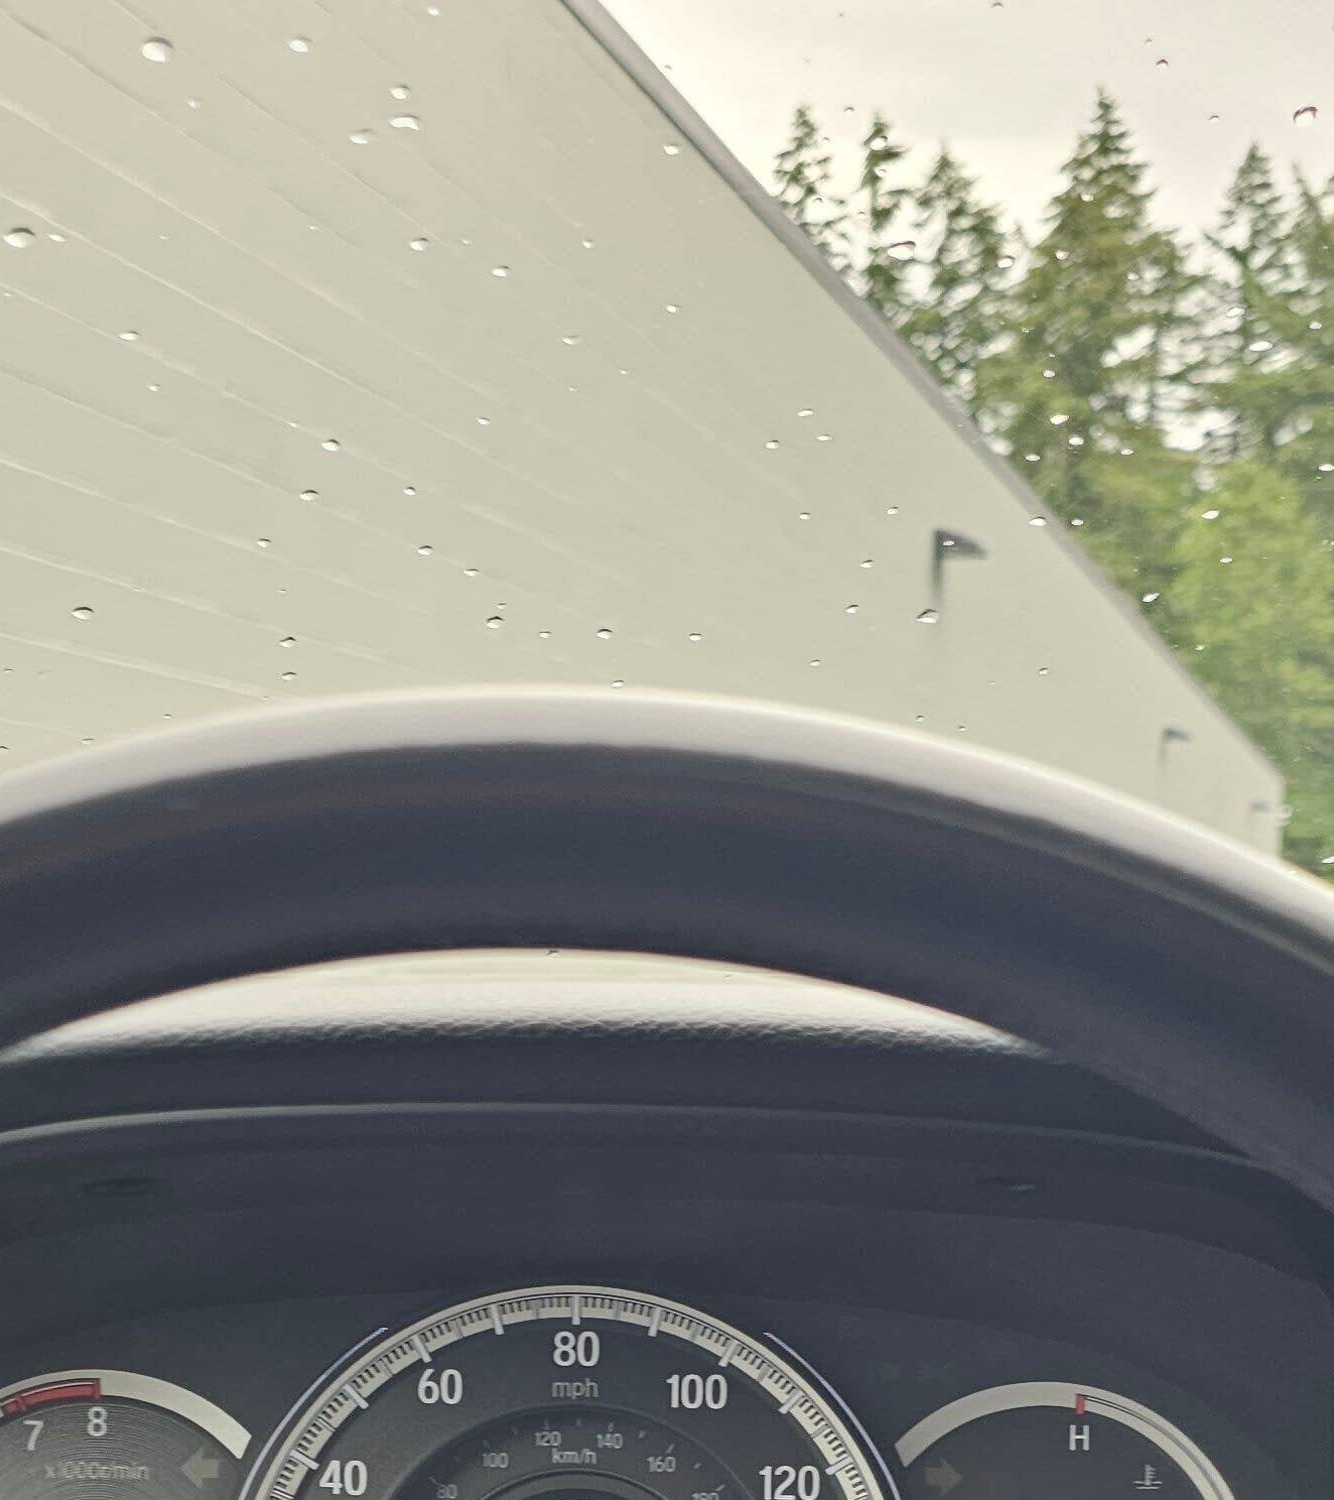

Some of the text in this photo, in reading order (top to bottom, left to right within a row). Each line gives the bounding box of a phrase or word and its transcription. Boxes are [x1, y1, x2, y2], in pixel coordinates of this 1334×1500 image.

[553, 1332, 600, 1367] 80
[417, 1368, 463, 1404] 60
[552, 1379, 599, 1402] mph
[666, 1375, 727, 1410] 100
[86, 1406, 108, 1437] 8
[23, 1420, 44, 1451] 7
[535, 1431, 562, 1447] 120
[597, 1433, 623, 1449] 140
[1069, 1425, 1090, 1451] H
[482, 1452, 509, 1469] 100
[551, 1449, 597, 1465] km/h
[646, 1456, 676, 1473] 160
[319, 1460, 367, 1496] 40
